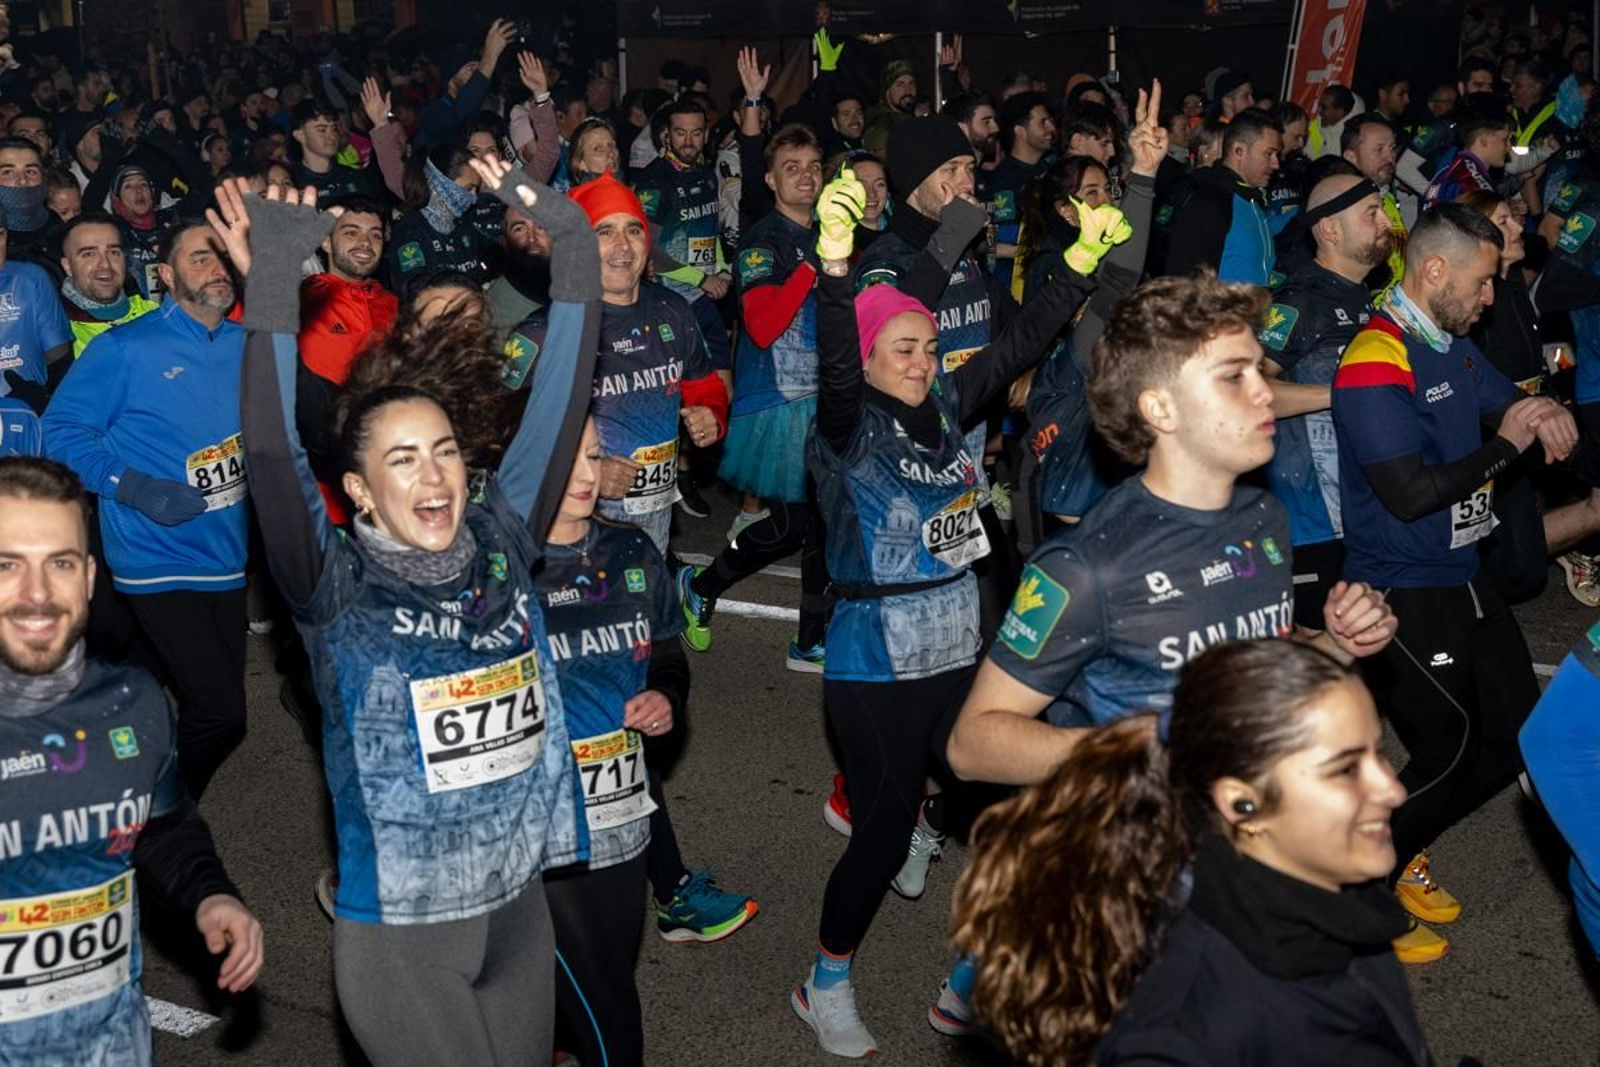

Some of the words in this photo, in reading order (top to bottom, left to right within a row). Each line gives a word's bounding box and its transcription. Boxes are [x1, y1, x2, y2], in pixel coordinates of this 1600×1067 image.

[934, 306, 961, 331] AN
[392, 606, 461, 641] SAN
[1158, 622, 1228, 671] SAN
[434, 685, 539, 746] 6774
[0, 750, 46, 780] jaén
[0, 911, 123, 975] 7060
